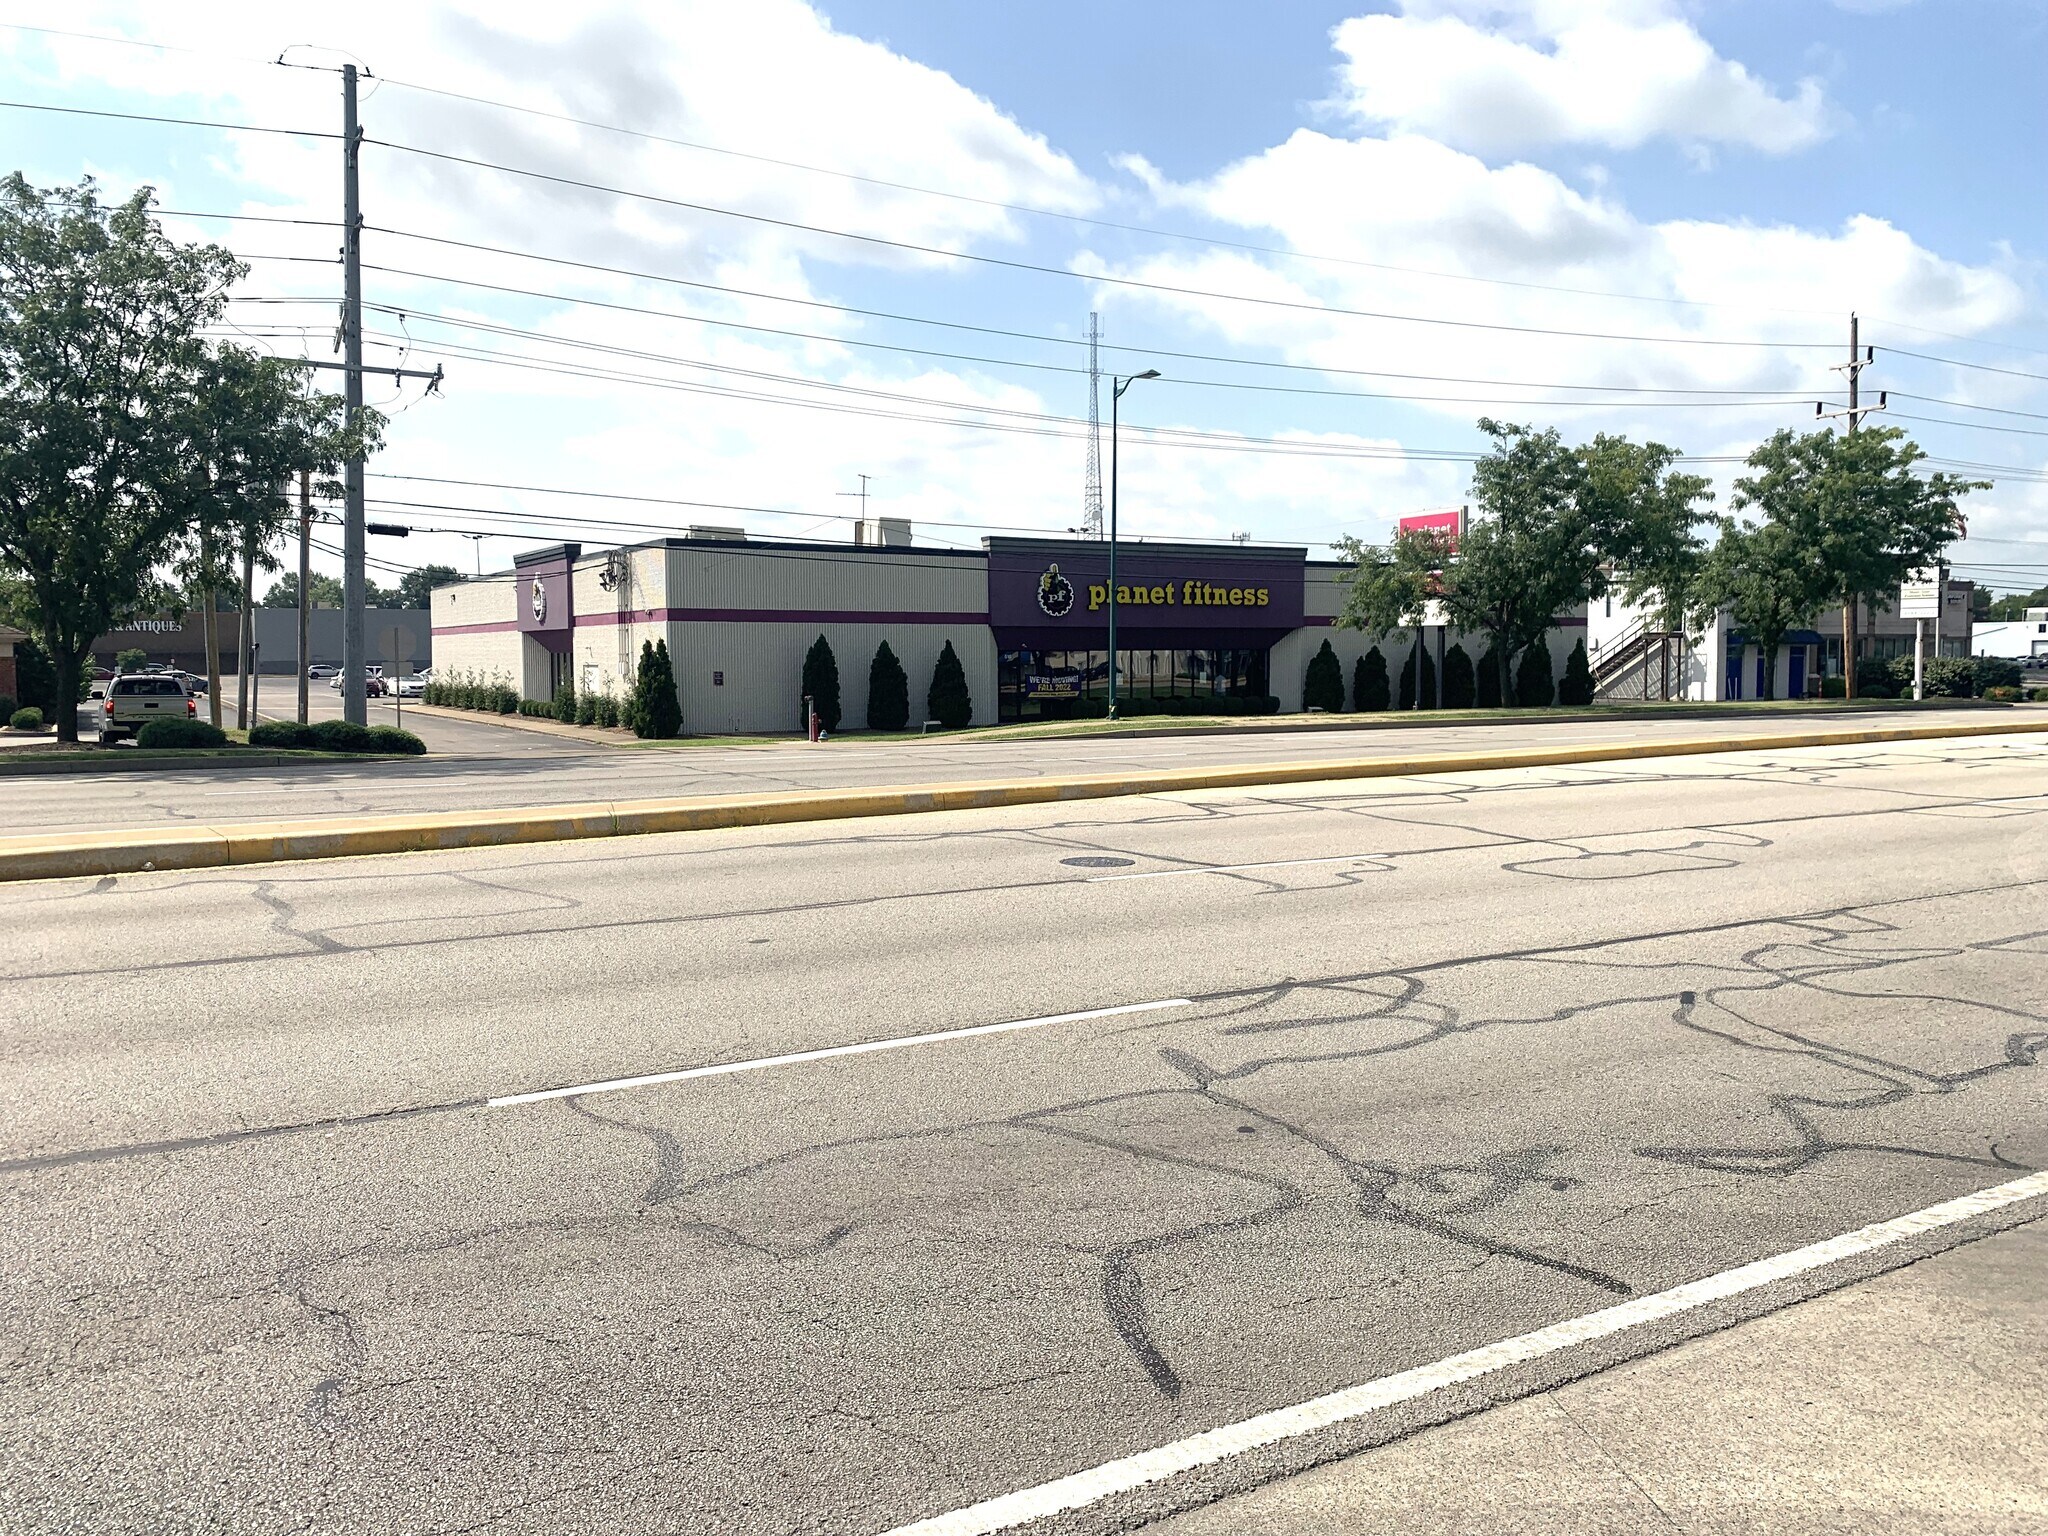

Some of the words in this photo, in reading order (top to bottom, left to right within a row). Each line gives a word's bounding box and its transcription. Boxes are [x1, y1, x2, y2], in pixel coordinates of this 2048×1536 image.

[1048, 590, 1066, 603] pf
[1089, 579, 1175, 610] planet
[1183, 580, 1269, 606] fitness
[125, 620, 182, 634] ANTIQUES
[1037, 683, 1054, 691] FALL
[1055, 683, 1071, 691] 2022
